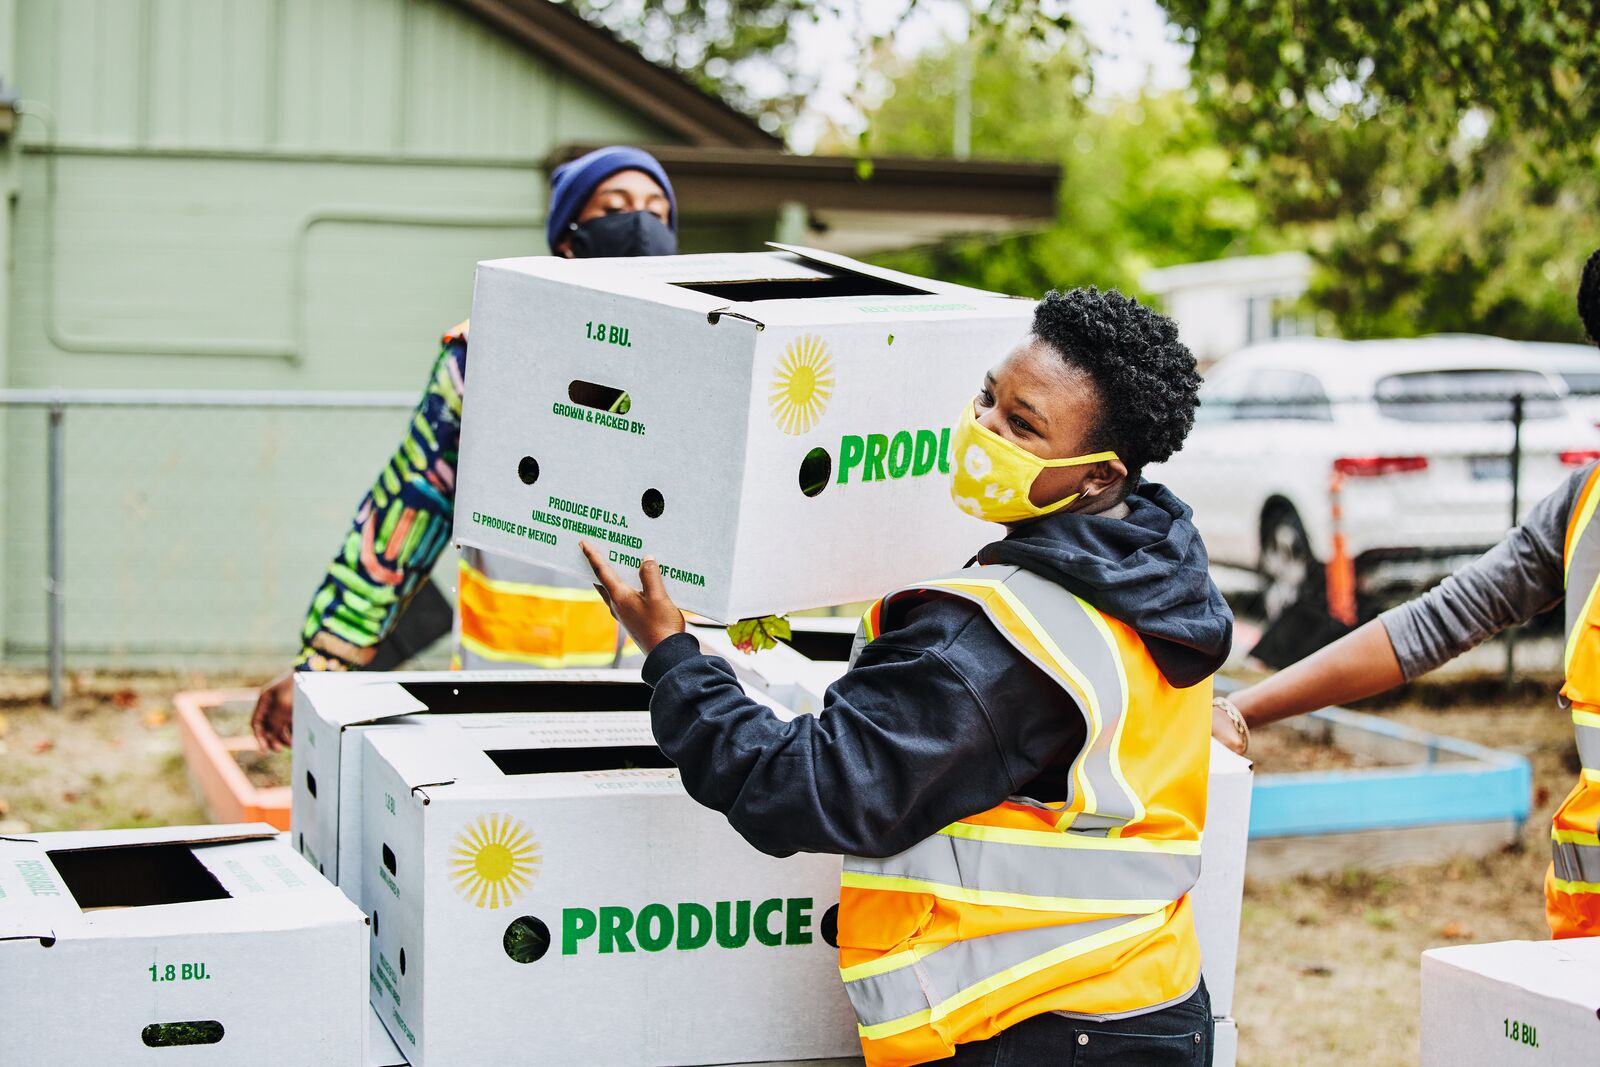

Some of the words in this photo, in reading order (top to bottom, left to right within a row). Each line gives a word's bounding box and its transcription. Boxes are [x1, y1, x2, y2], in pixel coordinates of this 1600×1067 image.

[585, 321, 606, 341] 1.8
[608, 325, 632, 347] BU.
[552, 402, 585, 420] GROWN
[585, 410, 593, 423] &
[594, 412, 629, 431] PACKED
[630, 421, 646, 435] BY:
[836, 427, 951, 485] PRODU
[548, 496, 589, 518] PRODUCE
[589, 507, 603, 520] OF
[602, 510, 629, 528] U.S.A.
[481, 514, 516, 534] PRODUCE
[516, 524, 527, 537] OF
[527, 527, 557, 545] MEXICO
[532, 509, 561, 527] UNLESS
[561, 518, 607, 540] OTHERWISE
[608, 530, 643, 549] MARKED
[619, 553, 642, 569] PROD
[669, 567, 705, 587] CANADA
[561, 897, 814, 956] PRODUCE
[148, 963, 176, 982] 1.8
[181, 962, 211, 980] BU.
[1503, 1018, 1519, 1041] 1.8
[1521, 1022, 1539, 1048] BU.
